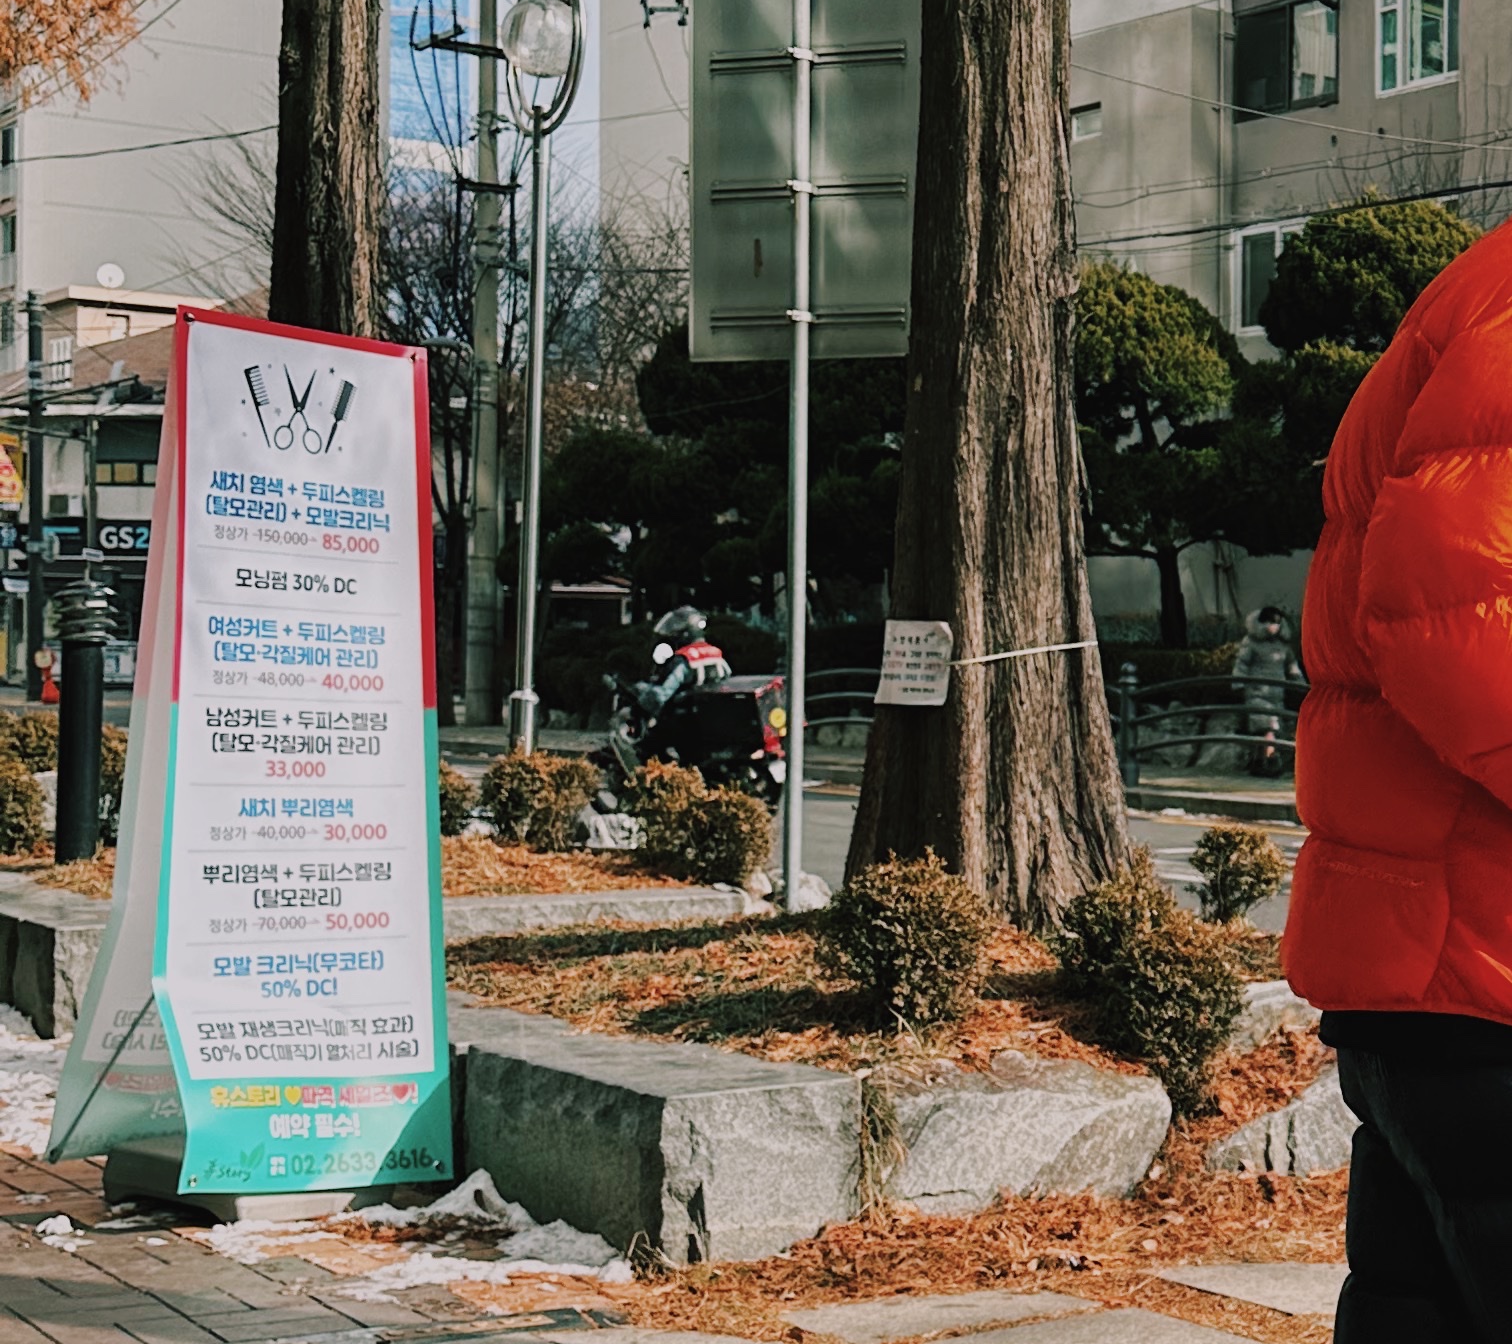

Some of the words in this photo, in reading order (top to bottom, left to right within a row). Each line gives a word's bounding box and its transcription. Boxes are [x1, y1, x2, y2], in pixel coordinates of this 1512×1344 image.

[210, 471, 244, 492] 새치
[250, 475, 284, 497] 염색
[206, 494, 288, 523] (탈모관리)
[305, 507, 391, 532] 모발크리닉
[214, 524, 248, 541] 정상가
[255, 529, 308, 546] 150,000
[322, 534, 380, 554] 85,000
[235, 568, 288, 591] 모닝펌
[292, 574, 330, 593] 30%
[334, 577, 358, 595] DC
[208, 616, 278, 639] 여성커트
[335, 648, 379, 669] 관리)
[212, 669, 248, 686] 정상가
[256, 670, 305, 687] 48,000
[321, 673, 385, 693] 40,000
[206, 707, 278, 729] 남성커트
[336, 735, 381, 756] 관리)
[265, 760, 326, 780] 33,000
[238, 797, 276, 818] 새치
[281, 797, 354, 818] 뿌리염색
[209, 825, 247, 842] 정상가
[256, 825, 306, 842] 40,000
[323, 823, 387, 844] 30,000
[202, 863, 279, 885] 뿌리염색
[253, 886, 343, 909] (탈모관리)
[209, 918, 247, 934] 정상가
[256, 916, 307, 931] 70,000
[325, 912, 391, 931] 50,000
[213, 955, 252, 977] 모발
[256, 949, 385, 975] 크리닉(무코타)
[261, 979, 302, 999] 50%
[306, 977, 339, 998] DC!
[197, 1021, 235, 1041] 모발
[371, 1014, 415, 1036] 효과)
[200, 1043, 242, 1063] 50%
[376, 1038, 420, 1060] 시술)
[269, 1112, 311, 1138] 예약
[314, 1111, 361, 1137] 필수!
